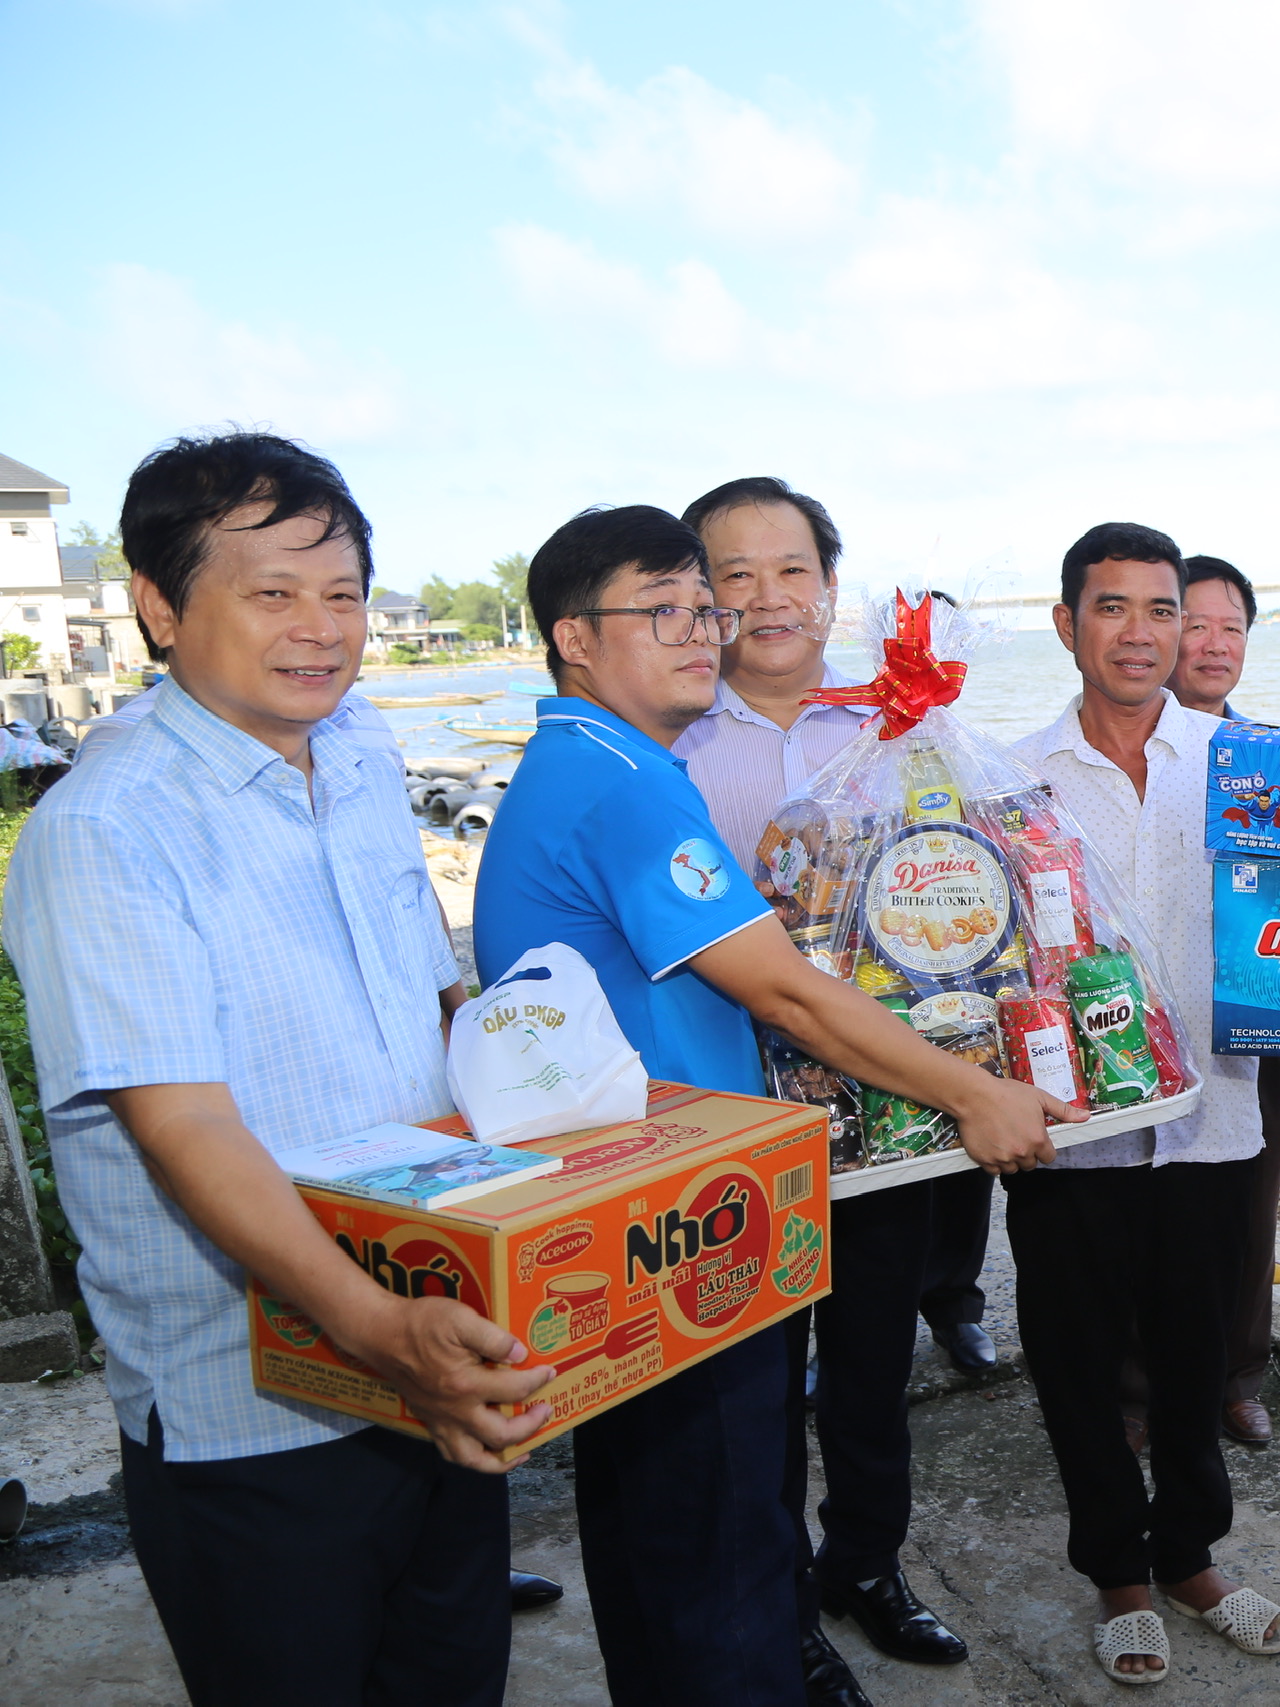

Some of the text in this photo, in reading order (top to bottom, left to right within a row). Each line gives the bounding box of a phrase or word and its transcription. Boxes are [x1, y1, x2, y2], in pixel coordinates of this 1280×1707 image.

[919, 795, 949, 806] Simply
[888, 853, 981, 893] Danisa
[891, 895, 986, 907] BUTTER COOKIES
[933, 886, 981, 894] TRADITIONAL
[1086, 1005, 1131, 1032] MILO
[1031, 1042, 1065, 1058] Select
[780, 1138, 792, 1148] CÔNG
[549, 1154, 650, 1185] happiness
[534, 1219, 593, 1249] Cook happiness
[626, 1184, 749, 1286] Nhớ
[697, 1249, 733, 1276] Hương vị
[782, 1248, 820, 1291] TOPPING
[788, 1247, 809, 1272] NHIỀU
[627, 1266, 691, 1306] mãi mãi
[697, 1258, 760, 1299] LẨU THÁI
[796, 1270, 813, 1290] HƠN
[697, 1282, 749, 1311] Noodles Thai
[697, 1286, 761, 1324] Hotpot Flavour
[550, 1390, 568, 1406] làm
[571, 1383, 581, 1395] từ
[583, 1366, 610, 1390] 36%
[614, 1355, 638, 1375] thành
[640, 1344, 661, 1363] phần
[554, 1399, 575, 1419] bột
[577, 1389, 602, 1409] (thay
[604, 1376, 619, 1395] thế
[622, 1367, 645, 1386] nhựa
[646, 1356, 662, 1373] PP)
